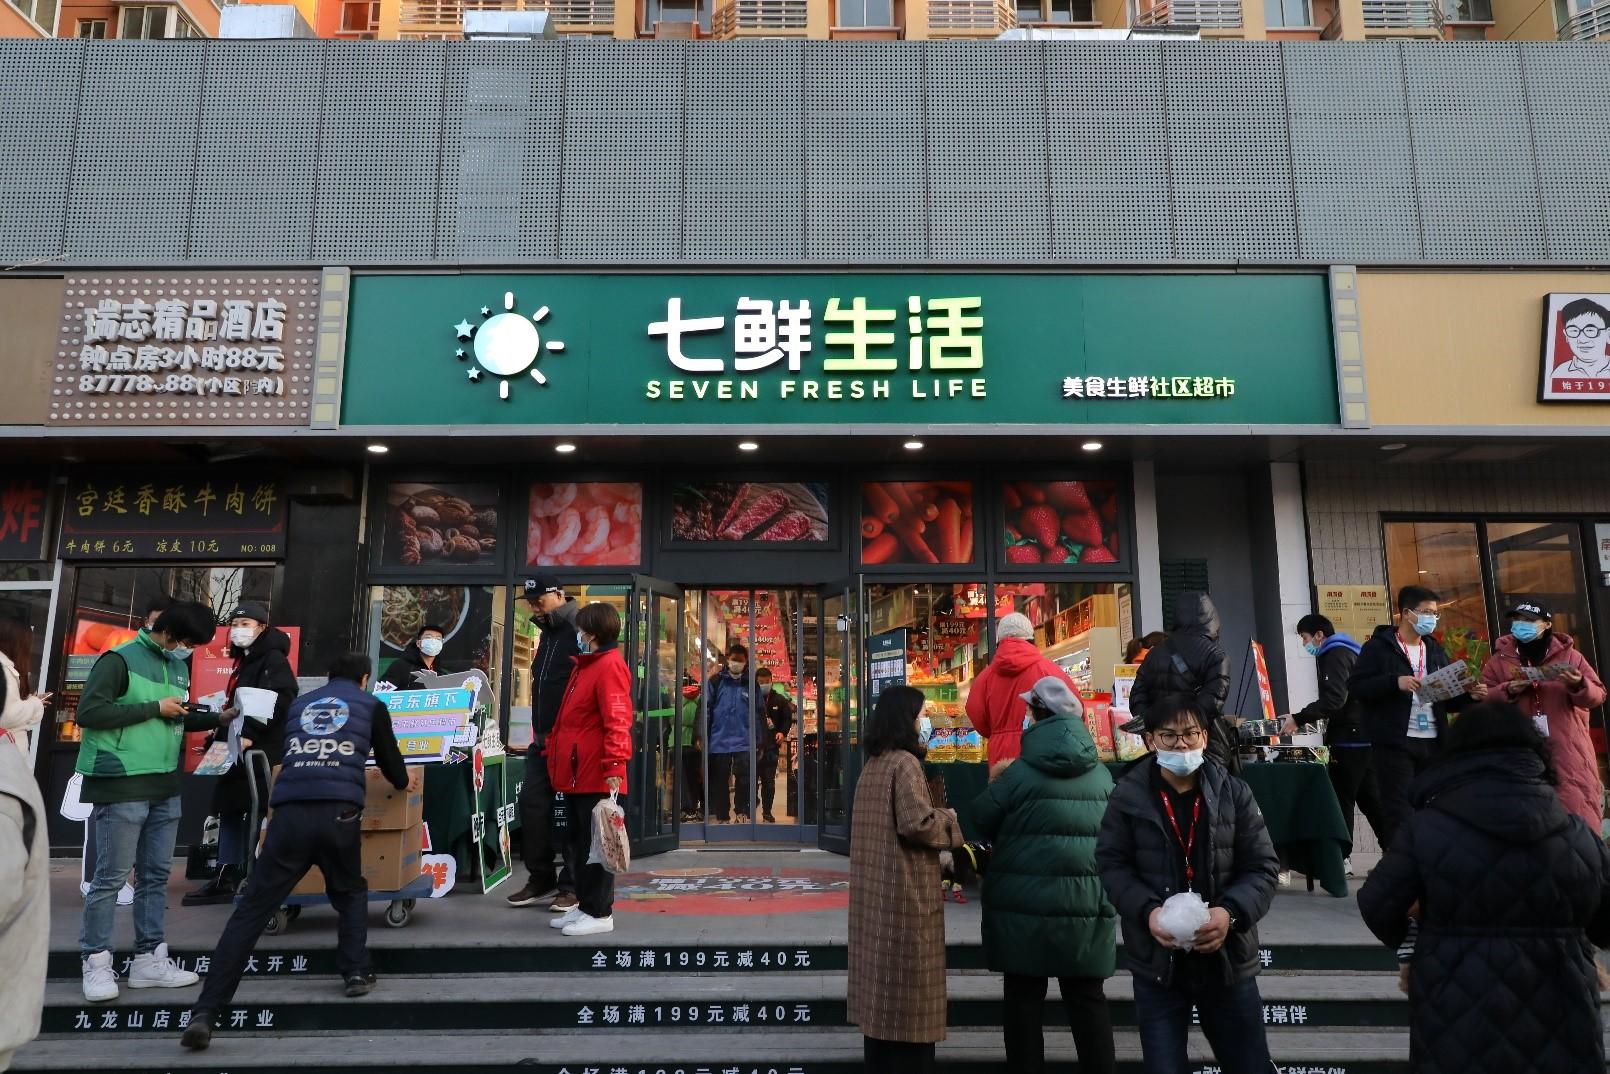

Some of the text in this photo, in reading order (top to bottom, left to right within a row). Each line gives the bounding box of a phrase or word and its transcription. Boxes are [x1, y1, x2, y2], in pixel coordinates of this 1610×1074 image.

[84, 298, 286, 343] 瑞志精品酒店
[647, 295, 984, 372] 七鲜生活
[80, 345, 284, 372] 钟点房3小时88元
[646, 378, 987, 399] SEVEN FRESH LIFE
[1063, 376, 1236, 398] 美食生鲜社区超市
[1562, 381, 1610, 390] 始于19
[76, 482, 278, 517] 宫廷香酥牛肉饼
[0, 482, 43, 543] 炸
[66, 540, 106, 554] 牛肉饼
[113, 540, 134, 553] 6元
[156, 540, 183, 553] 凉皮
[190, 540, 219, 553] 10元
[260, 544, 276, 553] 008
[388, 692, 458, 710] 京东旗下
[286, 737, 355, 760] Aepe
[592, 950, 811, 968] 全场满199元减40元
[74, 1009, 274, 1029] 九龙山店盛开业
[577, 1004, 811, 1024] 全场满199元减40元
